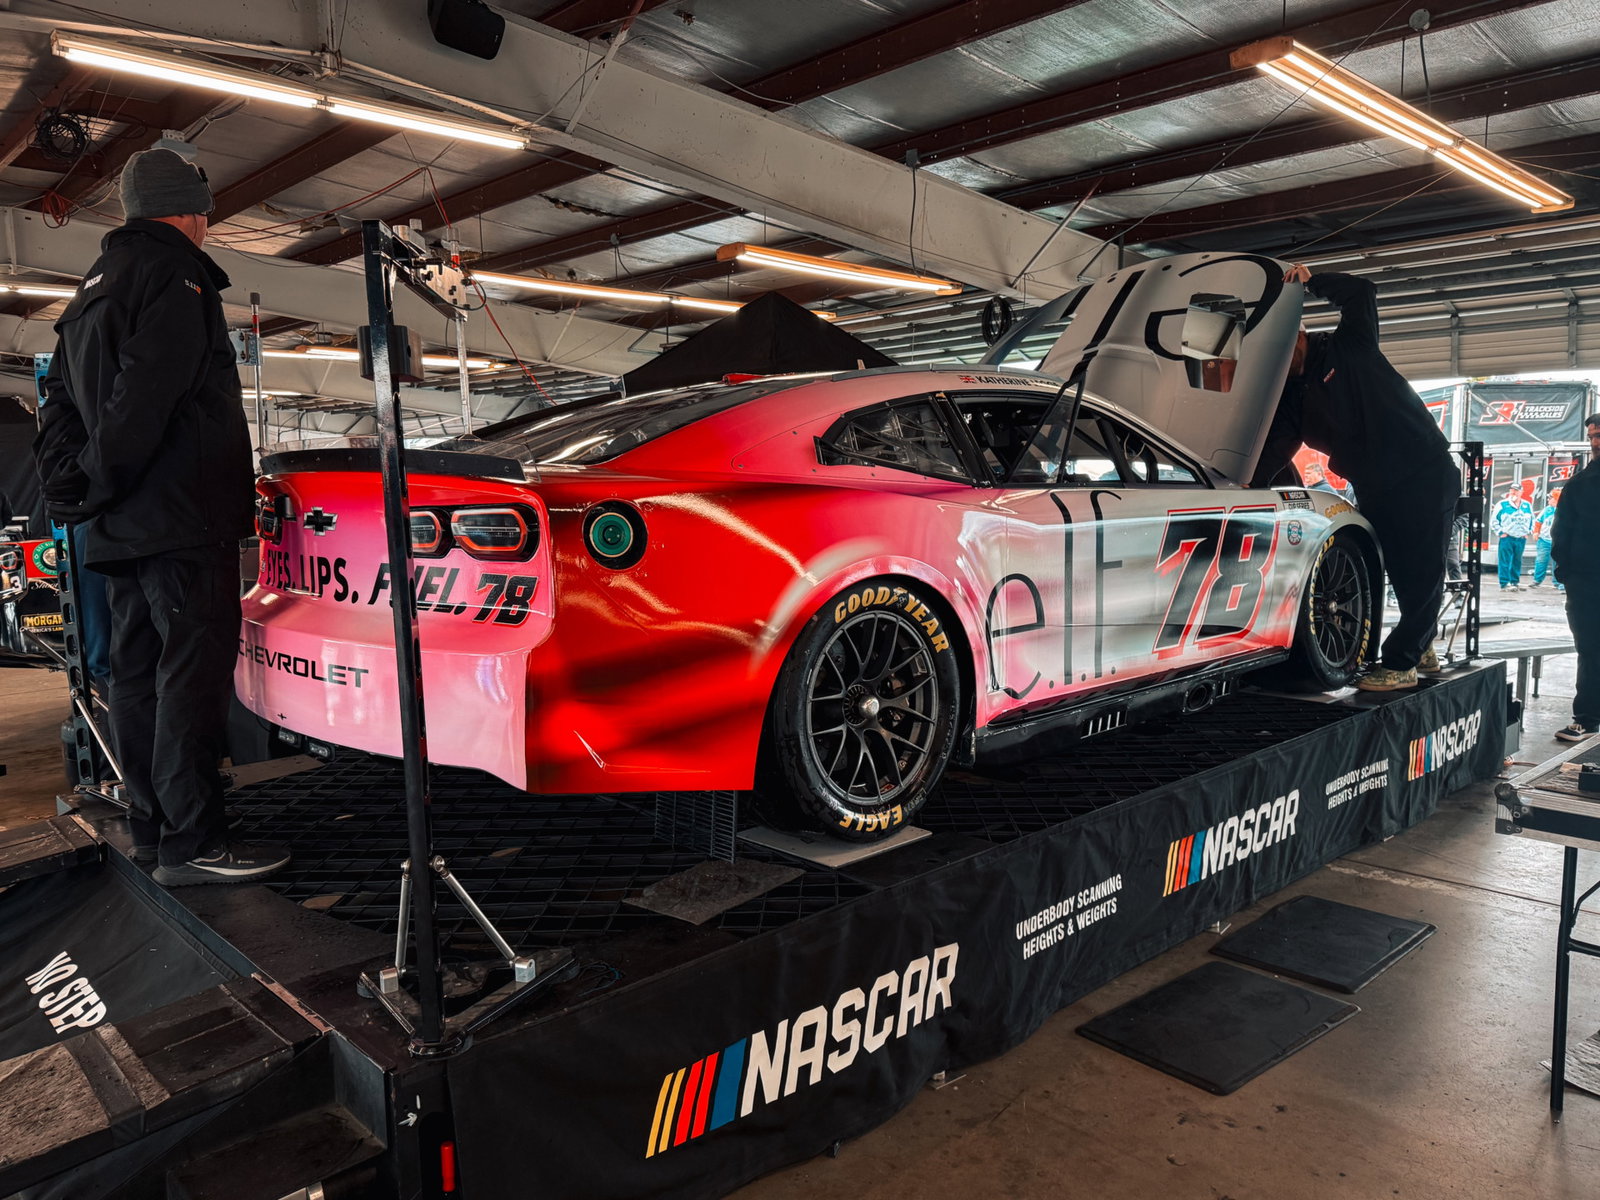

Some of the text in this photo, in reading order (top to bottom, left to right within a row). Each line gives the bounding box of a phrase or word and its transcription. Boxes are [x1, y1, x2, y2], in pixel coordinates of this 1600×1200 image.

[976, 375, 1031, 387] KATHERINE
[299, 554, 359, 603] LIPS.
[472, 573, 539, 628] 78
[1152, 504, 1280, 660] 78
[1430, 709, 1482, 772] NASCAR
[1325, 769, 1360, 795] UNDERBODY
[1328, 787, 1352, 810] HEIGHTS
[1359, 774, 1388, 794] WEIGHTS
[839, 804, 903, 832] EAGLE
[1201, 789, 1300, 881] NASCAR
[1016, 873, 1123, 940] UNDERBODY SCANNING
[1023, 897, 1118, 960] HEIGHTS & WEIGHTS
[25, 951, 107, 1034] NO STEP
[740, 942, 960, 1118] NASCAR
